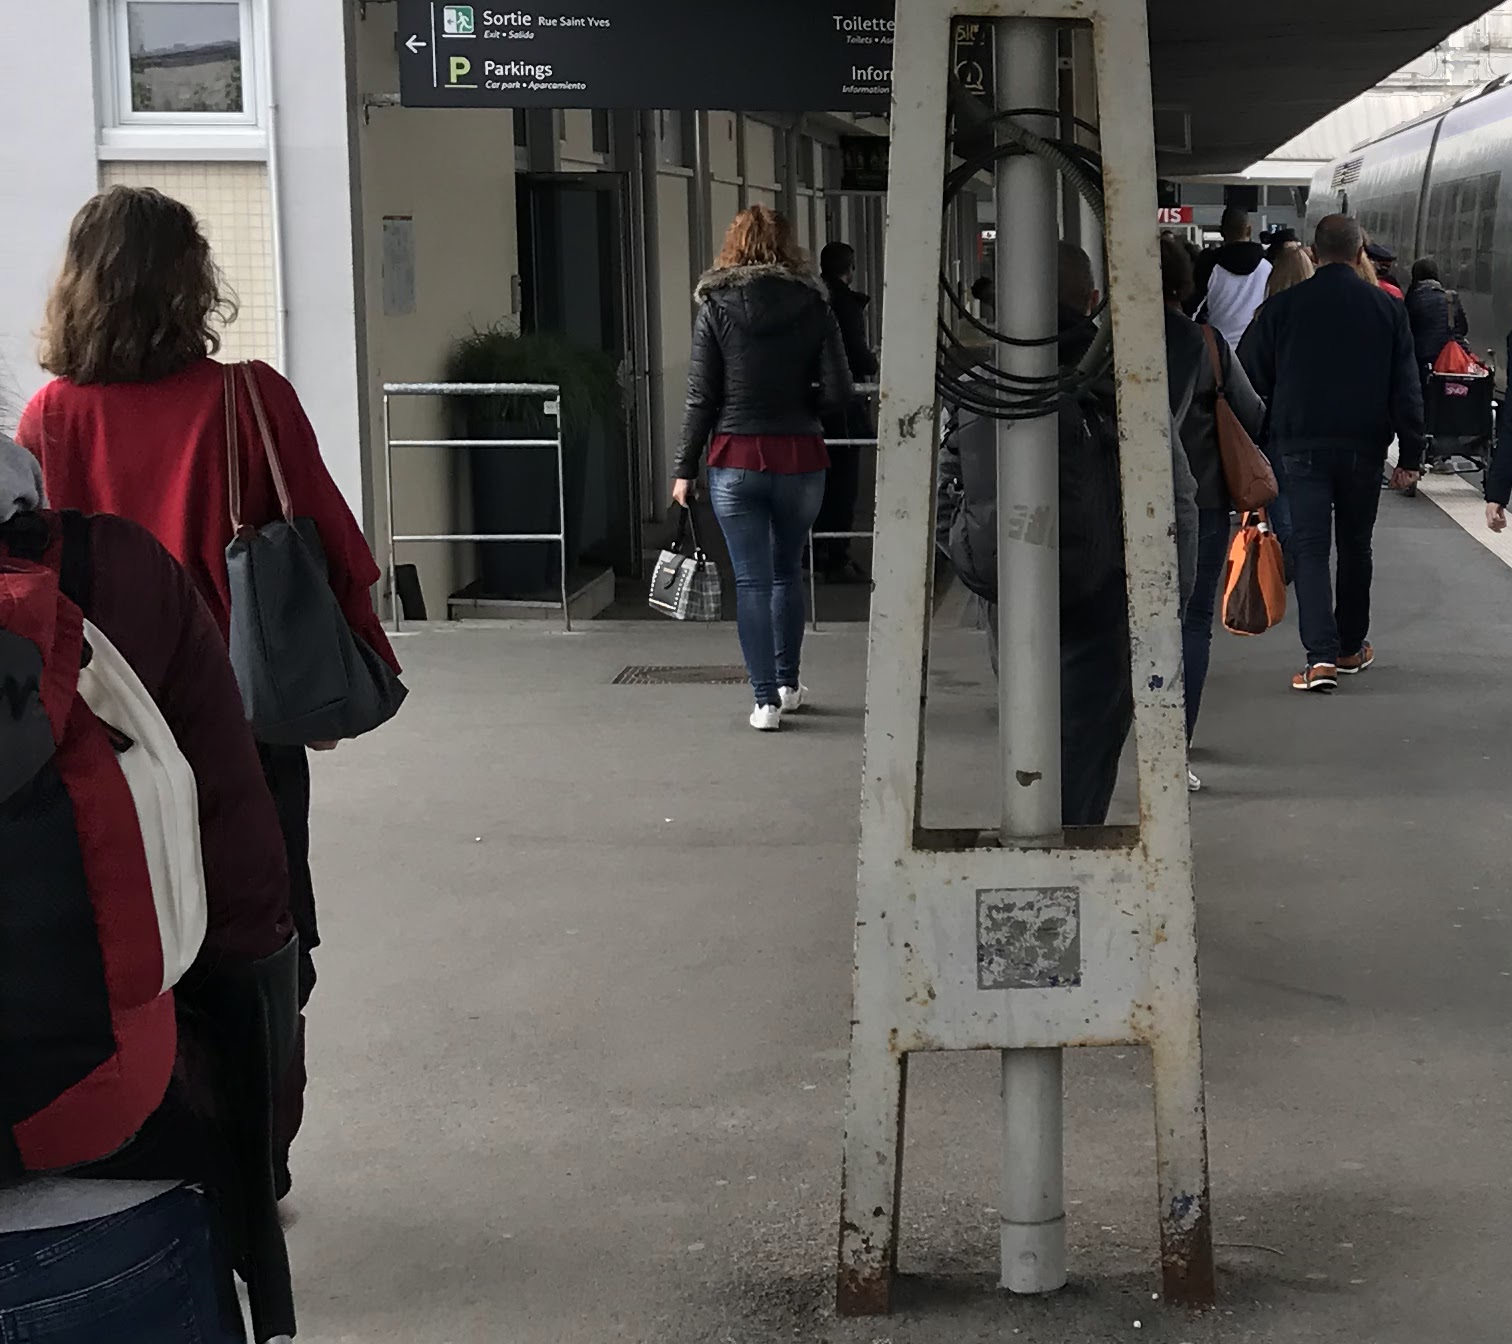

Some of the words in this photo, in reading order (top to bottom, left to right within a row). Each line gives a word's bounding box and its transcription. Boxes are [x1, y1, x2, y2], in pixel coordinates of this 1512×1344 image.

[482, 10, 532, 26] Sortie
[538, 16, 558, 27] Rue
[560, 16, 586, 27] Saint
[587, 17, 611, 27] Yves
[483, 30, 501, 39] Exit
[508, 30, 535, 39] Salida
[846, 35, 873, 44] Toilets
[484, 60, 553, 80] Parkings
[485, 80, 501, 89] Car
[501, 81, 521, 90] park
[528, 81, 587, 90] Aparcamiento
[842, 85, 890, 94] Information
